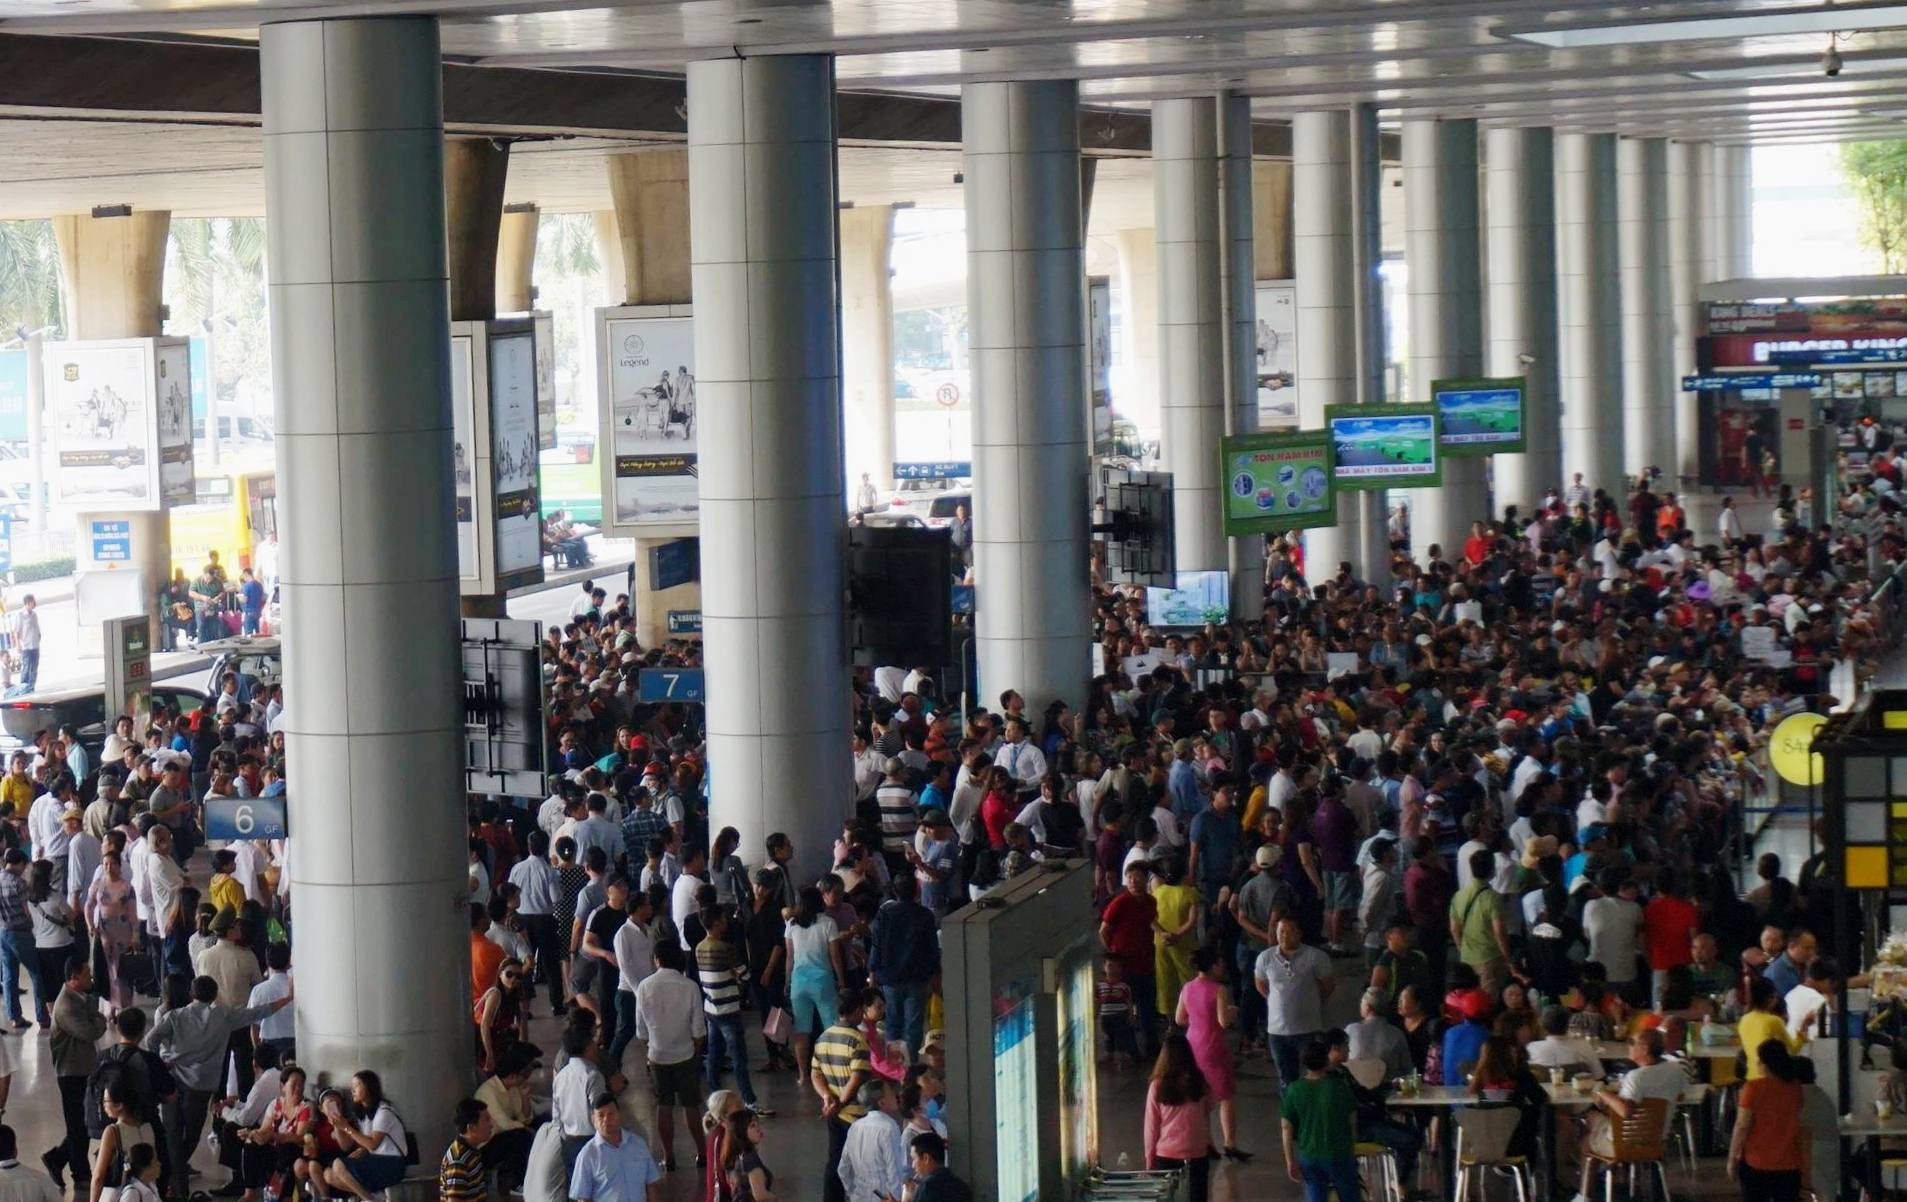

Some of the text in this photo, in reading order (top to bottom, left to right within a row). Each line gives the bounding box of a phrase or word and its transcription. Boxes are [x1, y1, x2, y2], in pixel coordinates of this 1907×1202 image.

[620, 358, 649, 367] Legend
[663, 674, 680, 698] 7
[235, 805, 254, 834] 6
